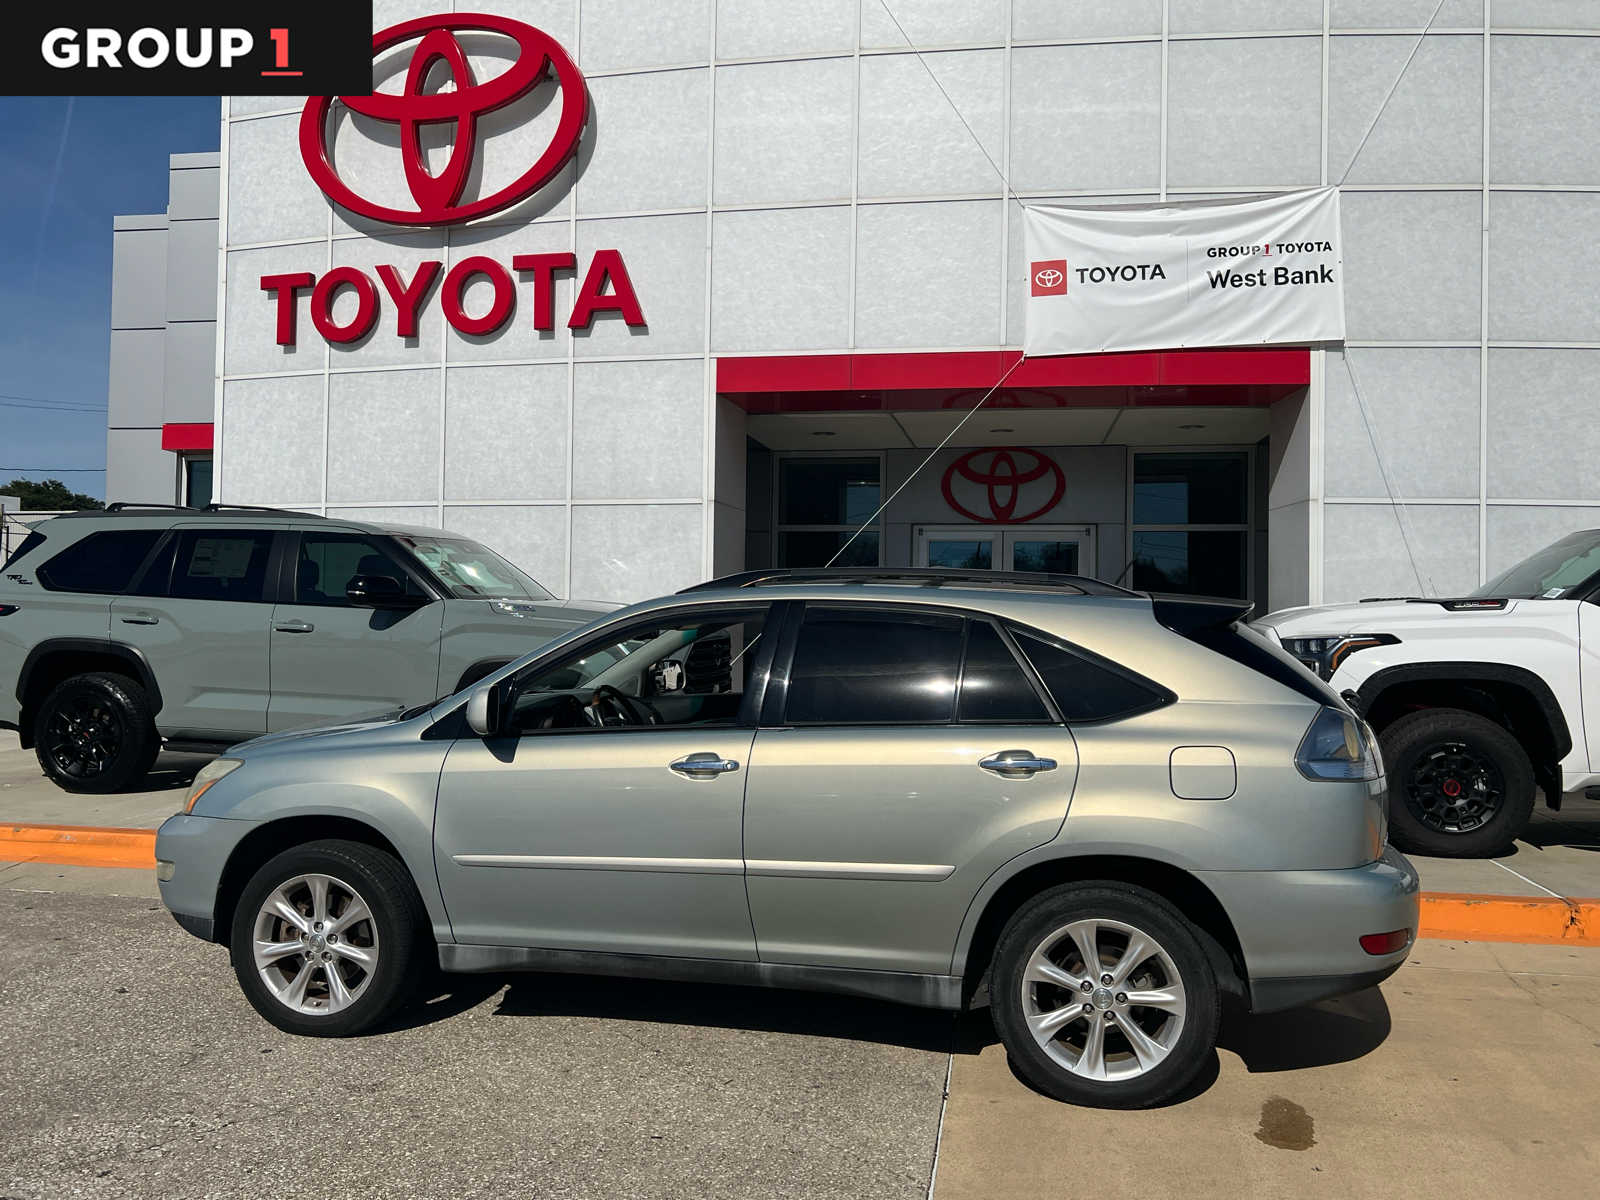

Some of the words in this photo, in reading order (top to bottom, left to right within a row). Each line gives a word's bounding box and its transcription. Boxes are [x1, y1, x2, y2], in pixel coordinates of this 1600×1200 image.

[1206, 245, 1262, 258] GROUP
[1263, 243, 1272, 257] 1
[1275, 241, 1333, 255] TOYOTA
[1075, 263, 1167, 284] TOYOTA
[1206, 268, 1267, 289] West
[1273, 264, 1335, 287] Bank
[260, 249, 648, 346] TOYOTA
